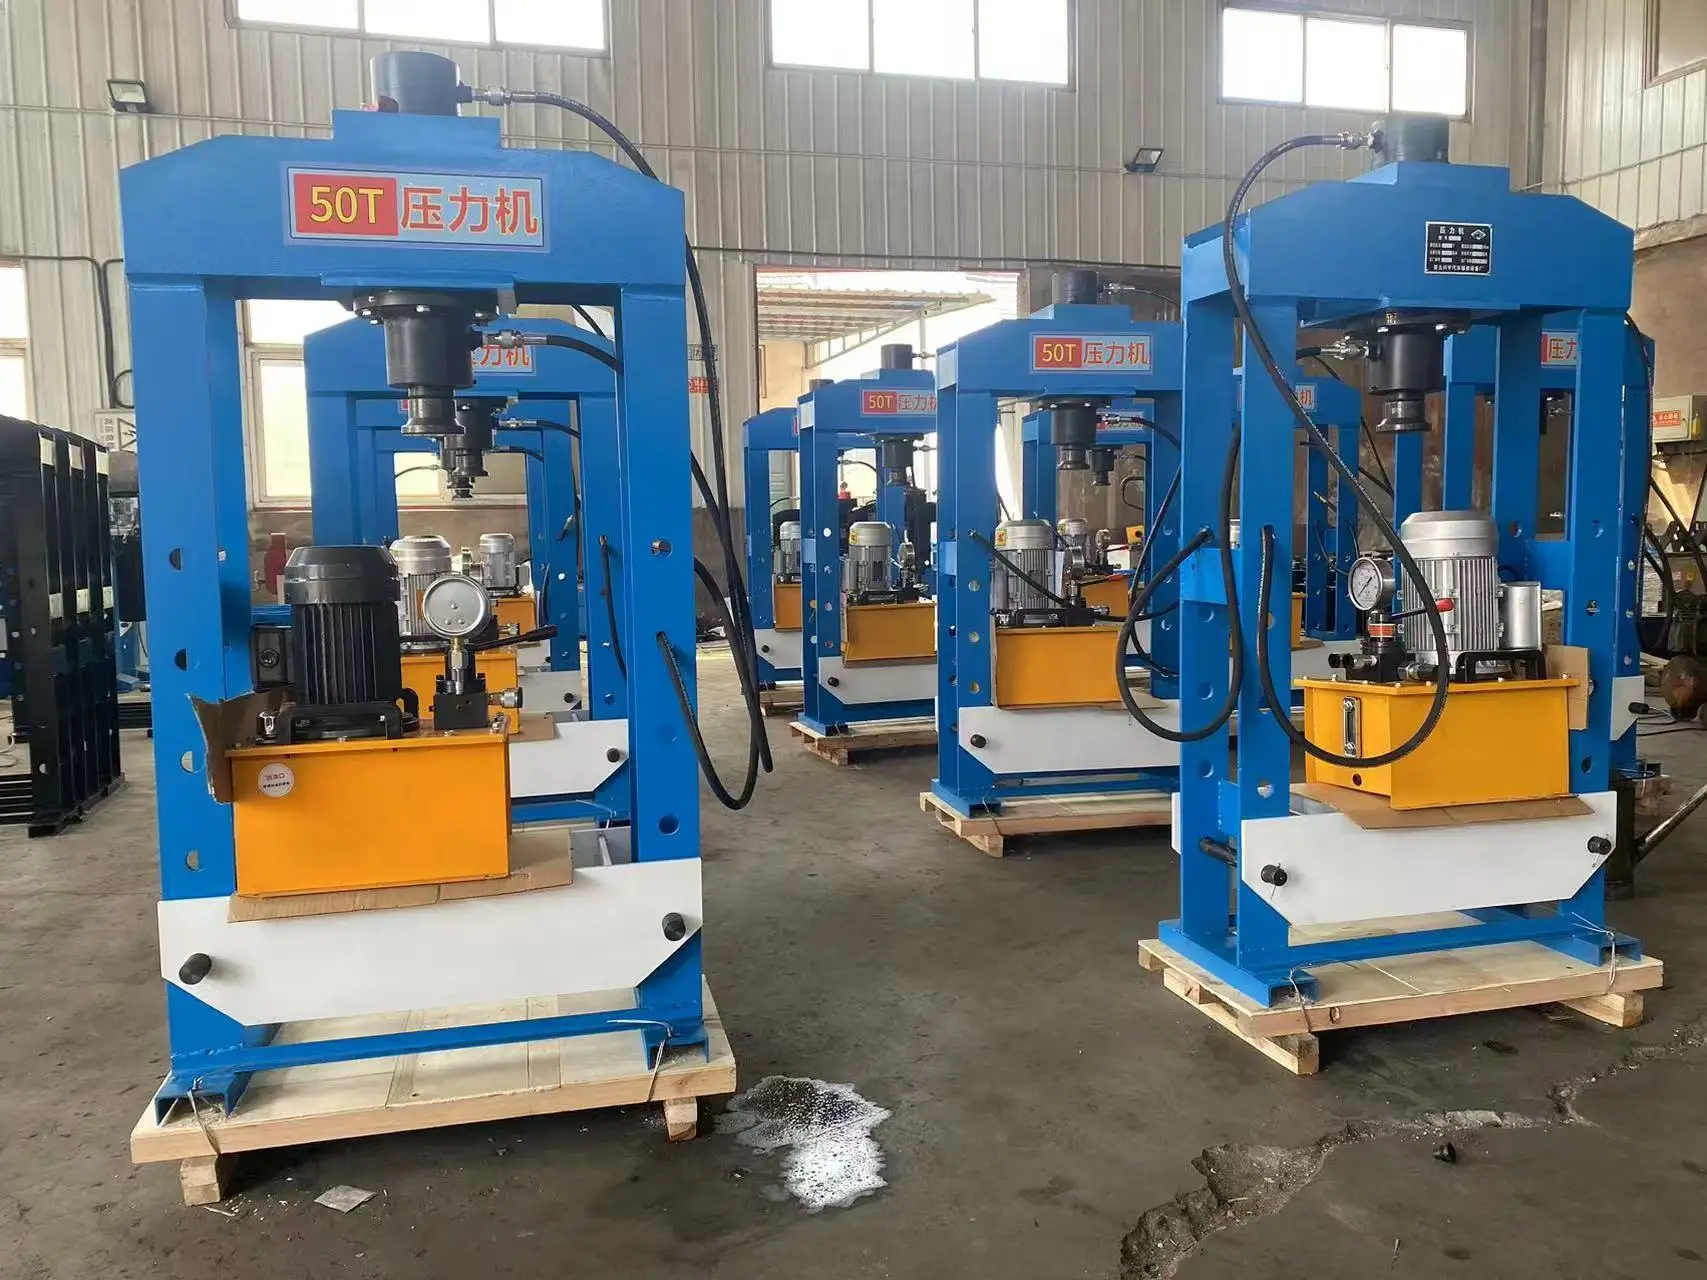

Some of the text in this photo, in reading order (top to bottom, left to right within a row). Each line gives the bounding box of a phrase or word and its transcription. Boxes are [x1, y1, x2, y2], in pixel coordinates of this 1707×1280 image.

[310, 185, 538, 236] 50T 压力机
[1042, 341, 1149, 365] 50T 压力机
[868, 395, 894, 409] 50T
